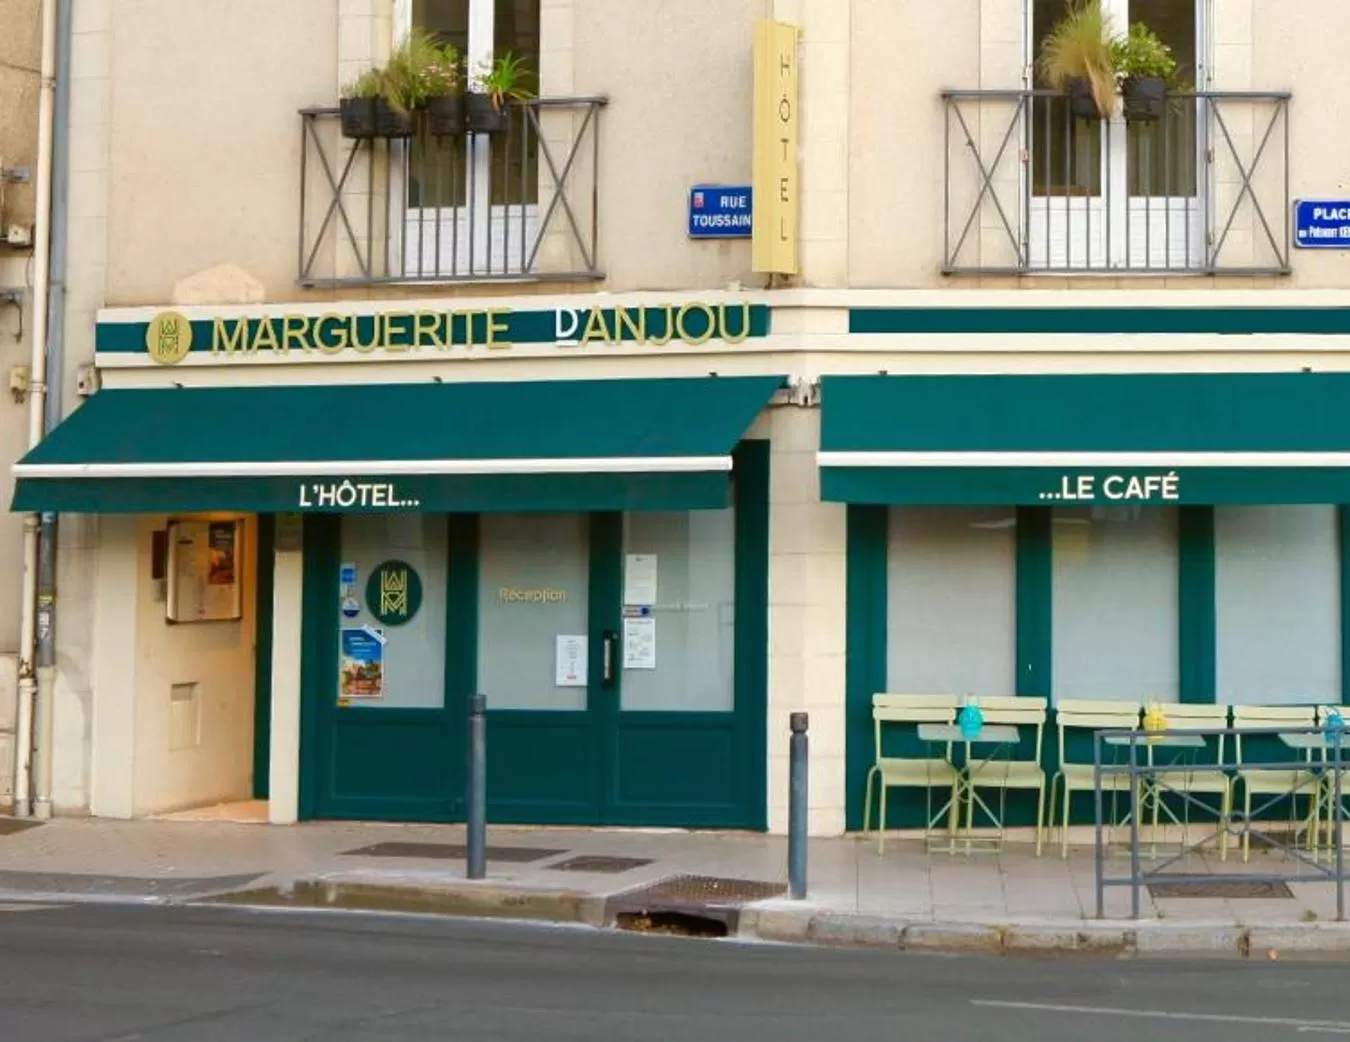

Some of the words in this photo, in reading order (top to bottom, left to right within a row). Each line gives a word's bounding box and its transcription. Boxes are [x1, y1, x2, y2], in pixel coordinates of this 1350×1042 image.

[778, 54, 792, 243] HÔTEL
[720, 195, 747, 209] RUE
[210, 305, 514, 357] MARGUERITE
[554, 301, 753, 348] D'ANJOU
[299, 479, 420, 507] L'HÔTEL...
[1038, 475, 1095, 500] ...LE
[1102, 470, 1180, 500] CAFÉ
